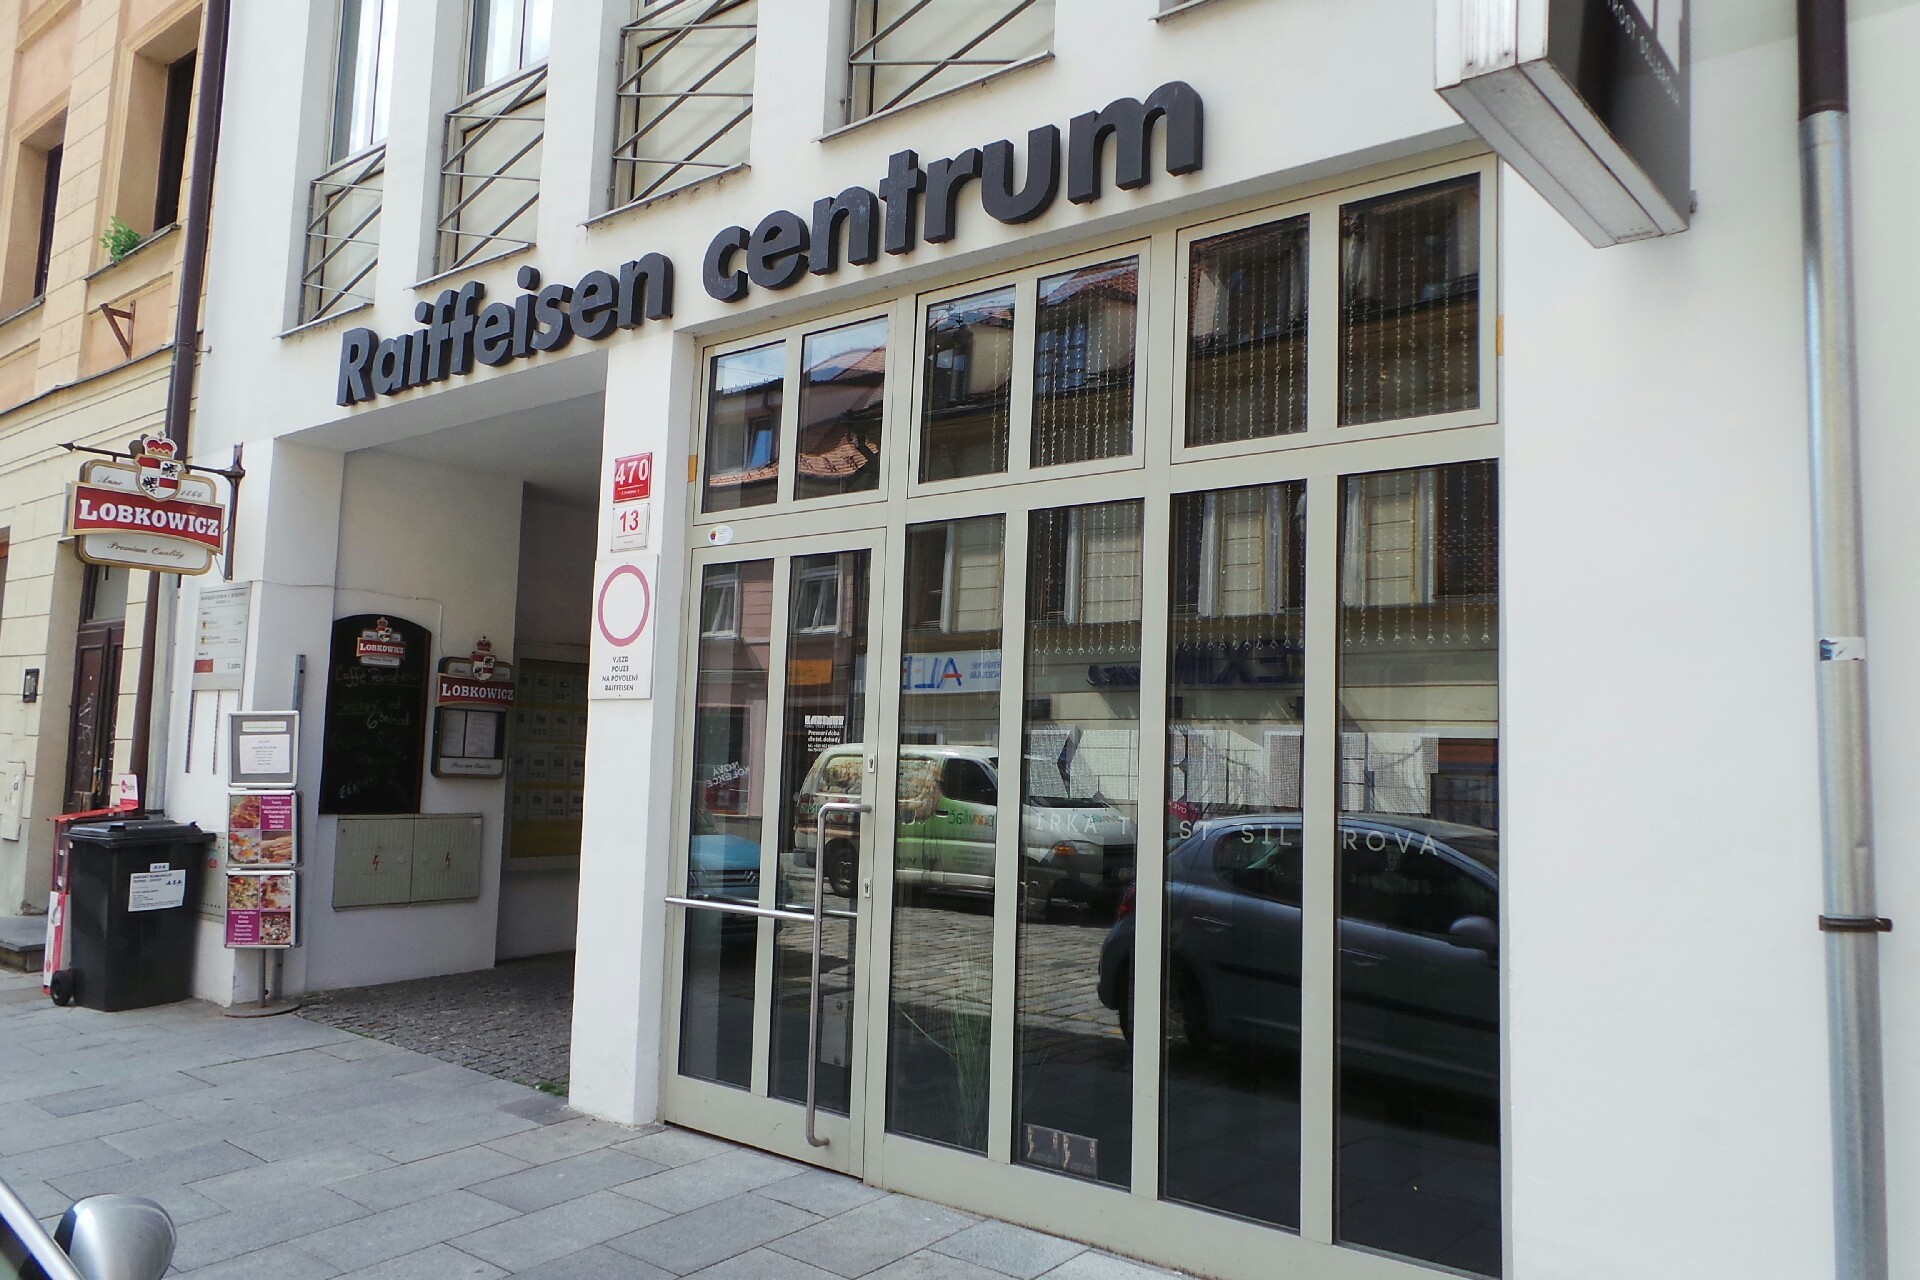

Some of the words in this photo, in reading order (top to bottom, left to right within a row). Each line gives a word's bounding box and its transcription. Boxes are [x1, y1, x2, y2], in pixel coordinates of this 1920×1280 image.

[336, 251, 674, 407] Raiffeisen
[702, 80, 1205, 303] centrum
[615, 458, 649, 486] 470
[79, 499, 220, 537] LOBKOWICZ
[619, 509, 640, 533] 13
[107, 542, 147, 554] Premium
[151, 546, 186, 560] Quality
[360, 643, 404, 655] LOBKOWICZ
[441, 683, 515, 702] LOBKOWICZ
